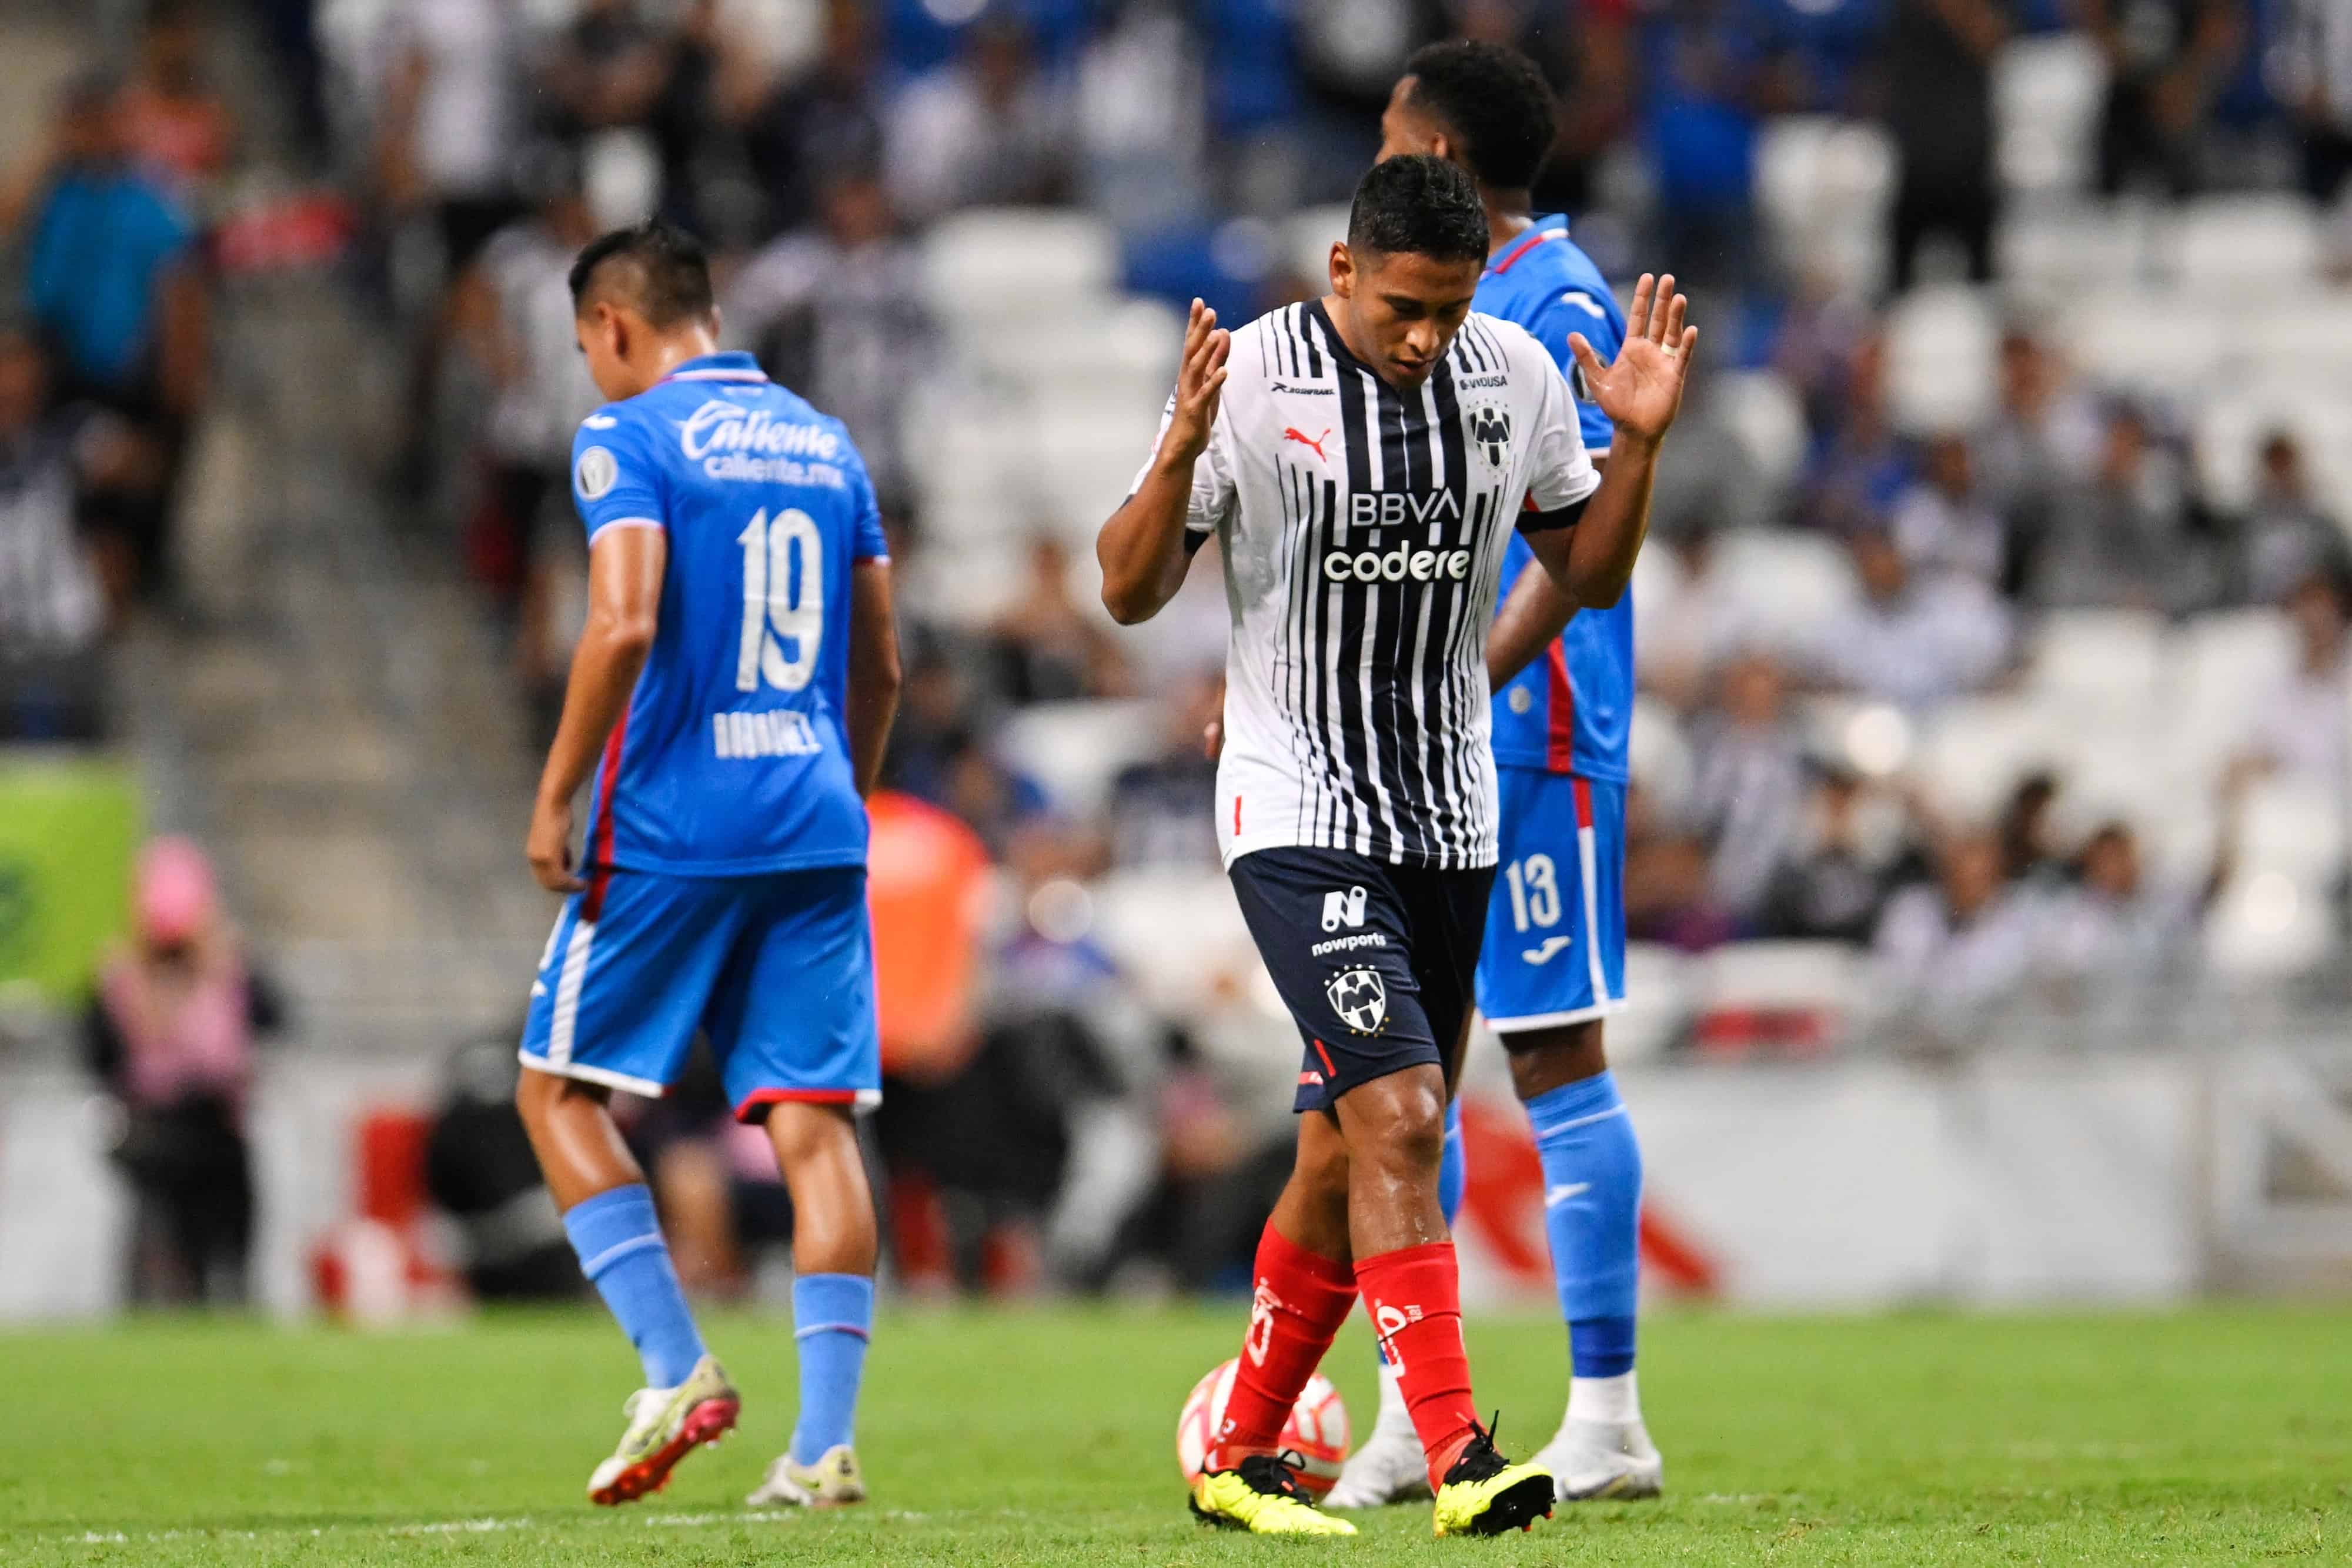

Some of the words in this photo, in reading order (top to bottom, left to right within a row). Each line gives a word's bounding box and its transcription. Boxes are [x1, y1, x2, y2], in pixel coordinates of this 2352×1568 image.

[1351, 487, 1461, 527] BBVA
[1324, 540, 1470, 582] codere
[736, 506, 823, 692] 19
[1505, 854, 1562, 932] 13
[1311, 932, 1387, 957] nowports
